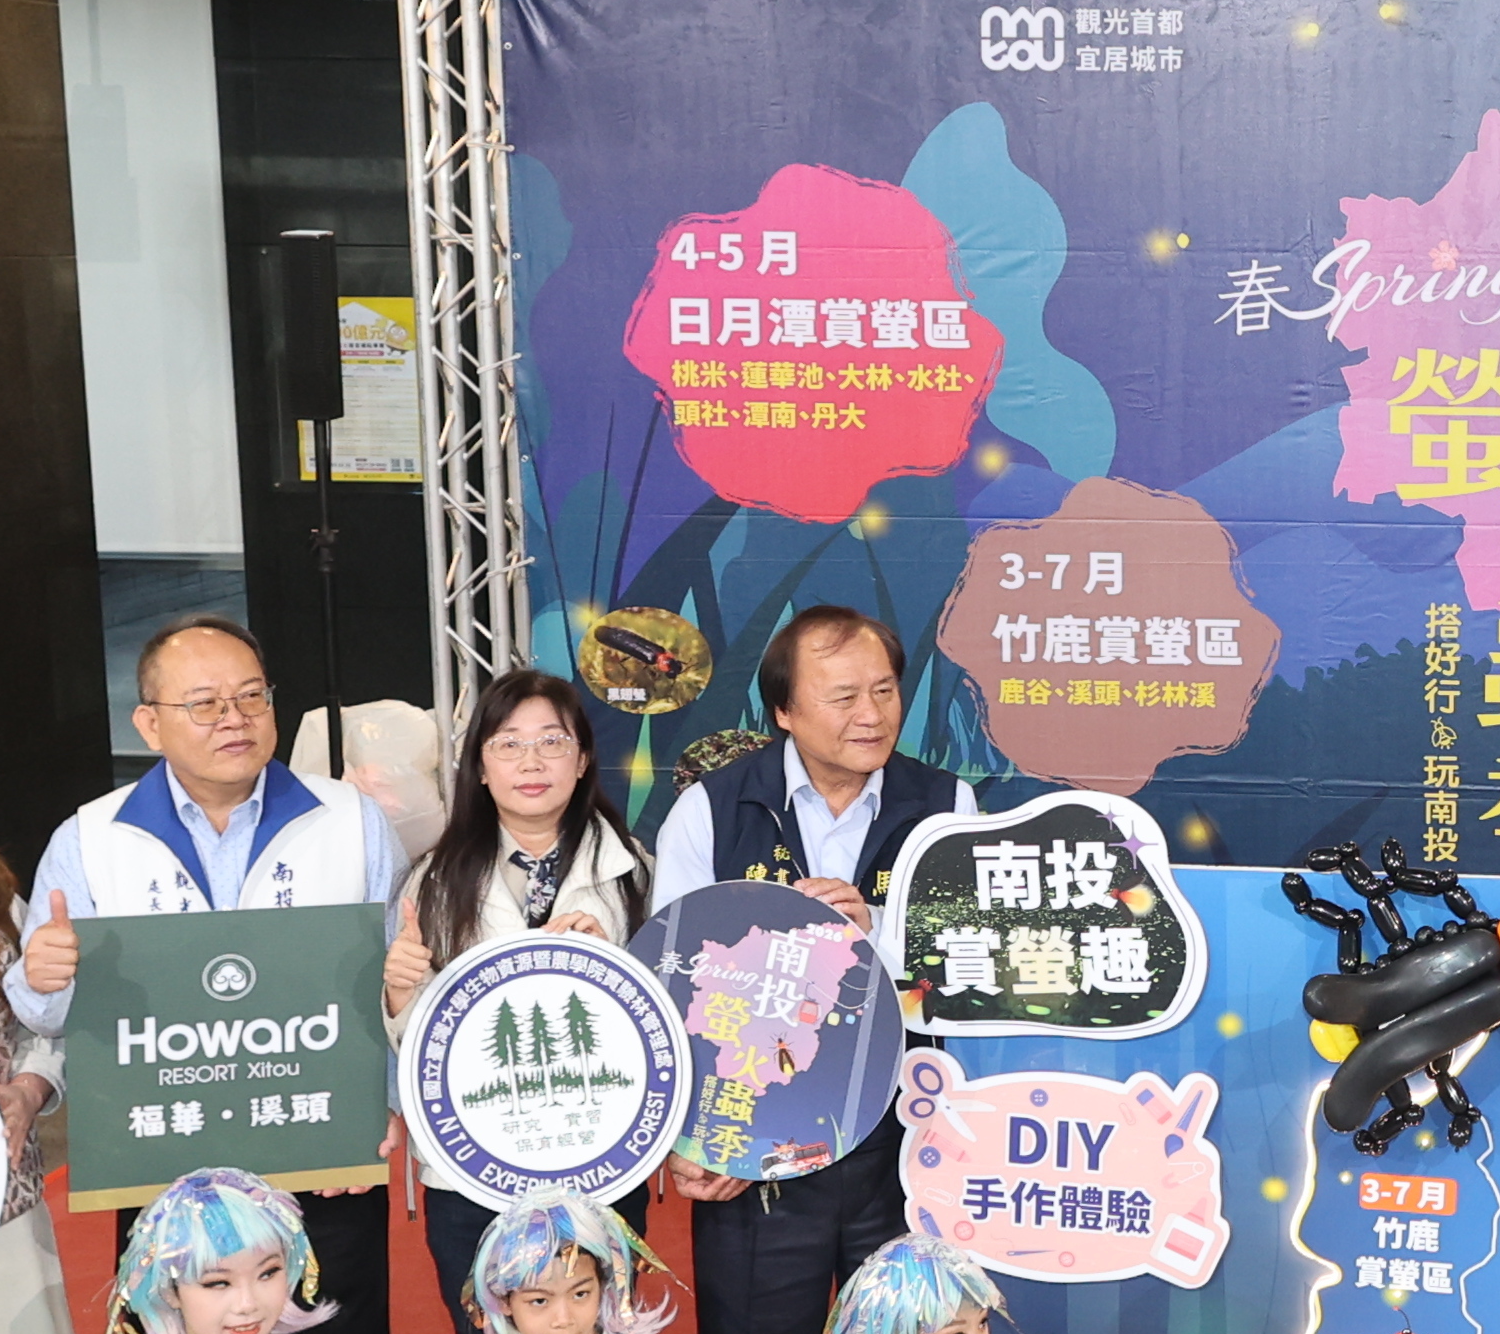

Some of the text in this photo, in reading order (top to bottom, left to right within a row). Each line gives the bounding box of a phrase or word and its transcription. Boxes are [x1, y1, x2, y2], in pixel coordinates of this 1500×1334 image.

[1075, 7, 1184, 36] 觀光首都
[1075, 45, 1184, 73] 宜居城市
[667, 296, 972, 351] 日月潭賞螢區
[1213, 257, 1292, 337] 春
[991, 613, 1244, 668] 竹鹿賞螢區
[1423, 602, 1463, 715] 搭好行
[1423, 754, 1463, 863] 玩南投
[973, 839, 1118, 911] 南投
[805, 922, 843, 944] 2026
[686, 953, 760, 991] Spring
[751, 927, 817, 1028] 南投
[934, 926, 1153, 998] 賞螢趣
[116, 1004, 340, 1066] Howard
[158, 1060, 301, 1086] RESORT Xitou
[435, 1116, 477, 1163] NTU
[625, 1089, 667, 1157] FOREST
[1007, 1115, 1118, 1172] DIY
[962, 1176, 1153, 1236] 手作體驗
[1373, 1217, 1440, 1253] 竹鹿
[1355, 1256, 1454, 1295] 賞螢區
